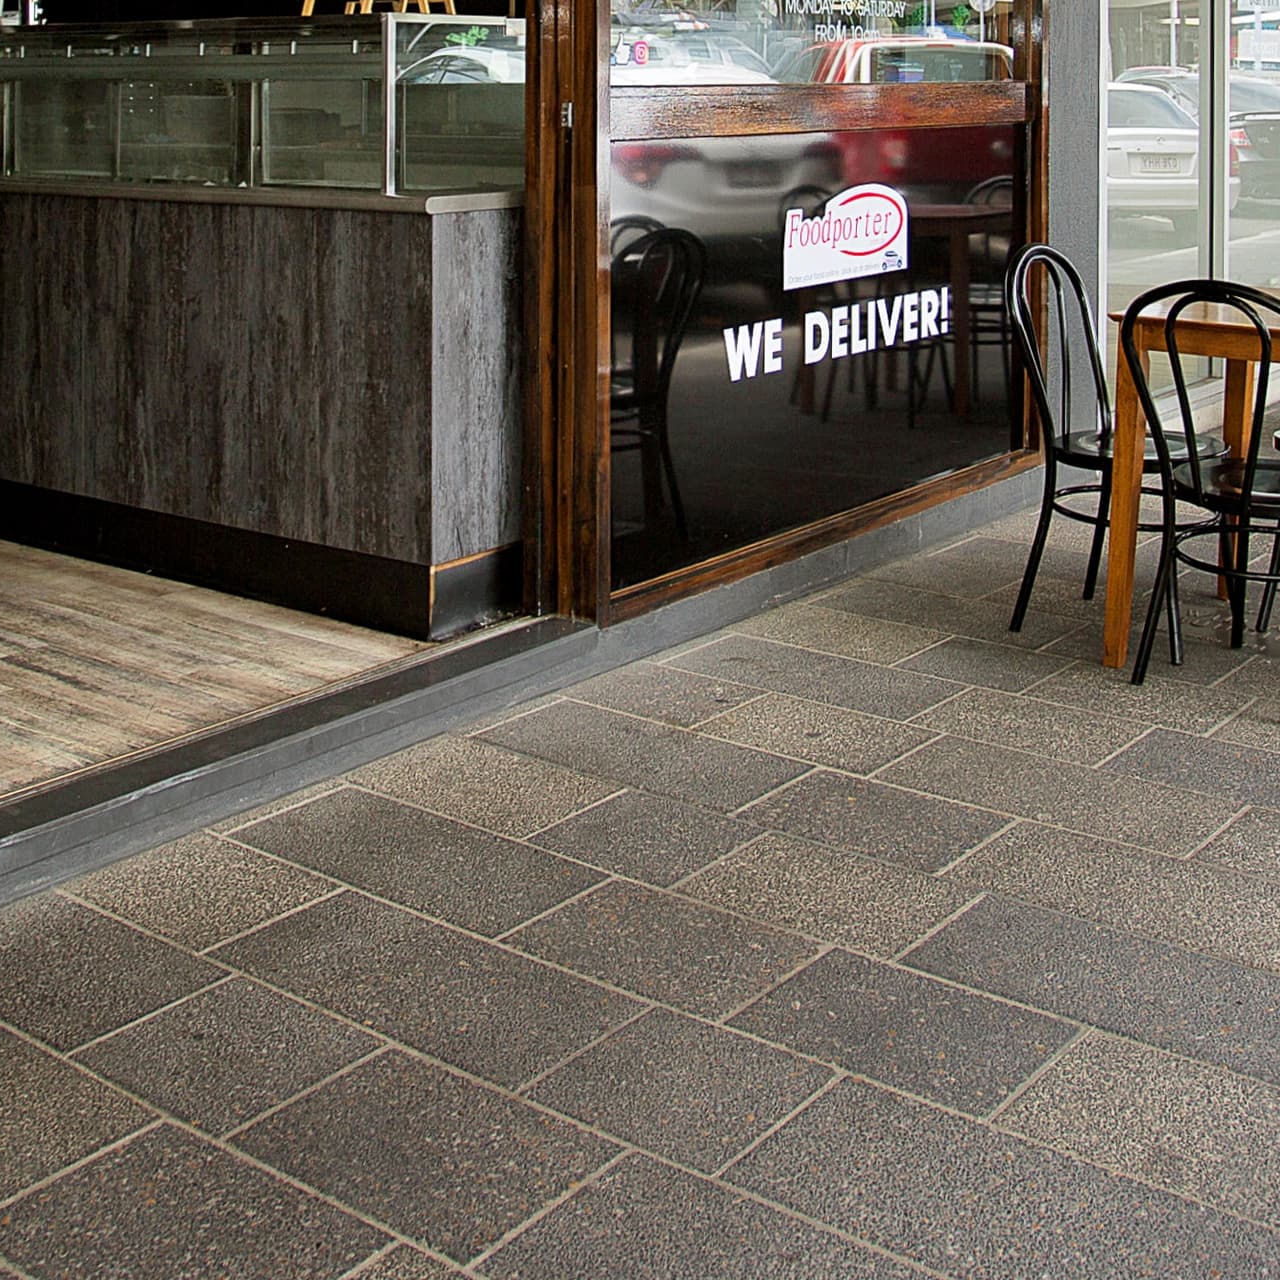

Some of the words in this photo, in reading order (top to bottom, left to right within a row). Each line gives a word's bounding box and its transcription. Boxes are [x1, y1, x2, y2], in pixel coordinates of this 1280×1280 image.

[858, 0, 907, 18] SATURDAY
[815, 24, 846, 42] FROM
[788, 210, 893, 249] Foodporter
[723, 318, 783, 383] WE
[804, 287, 950, 365] DELIVER!
